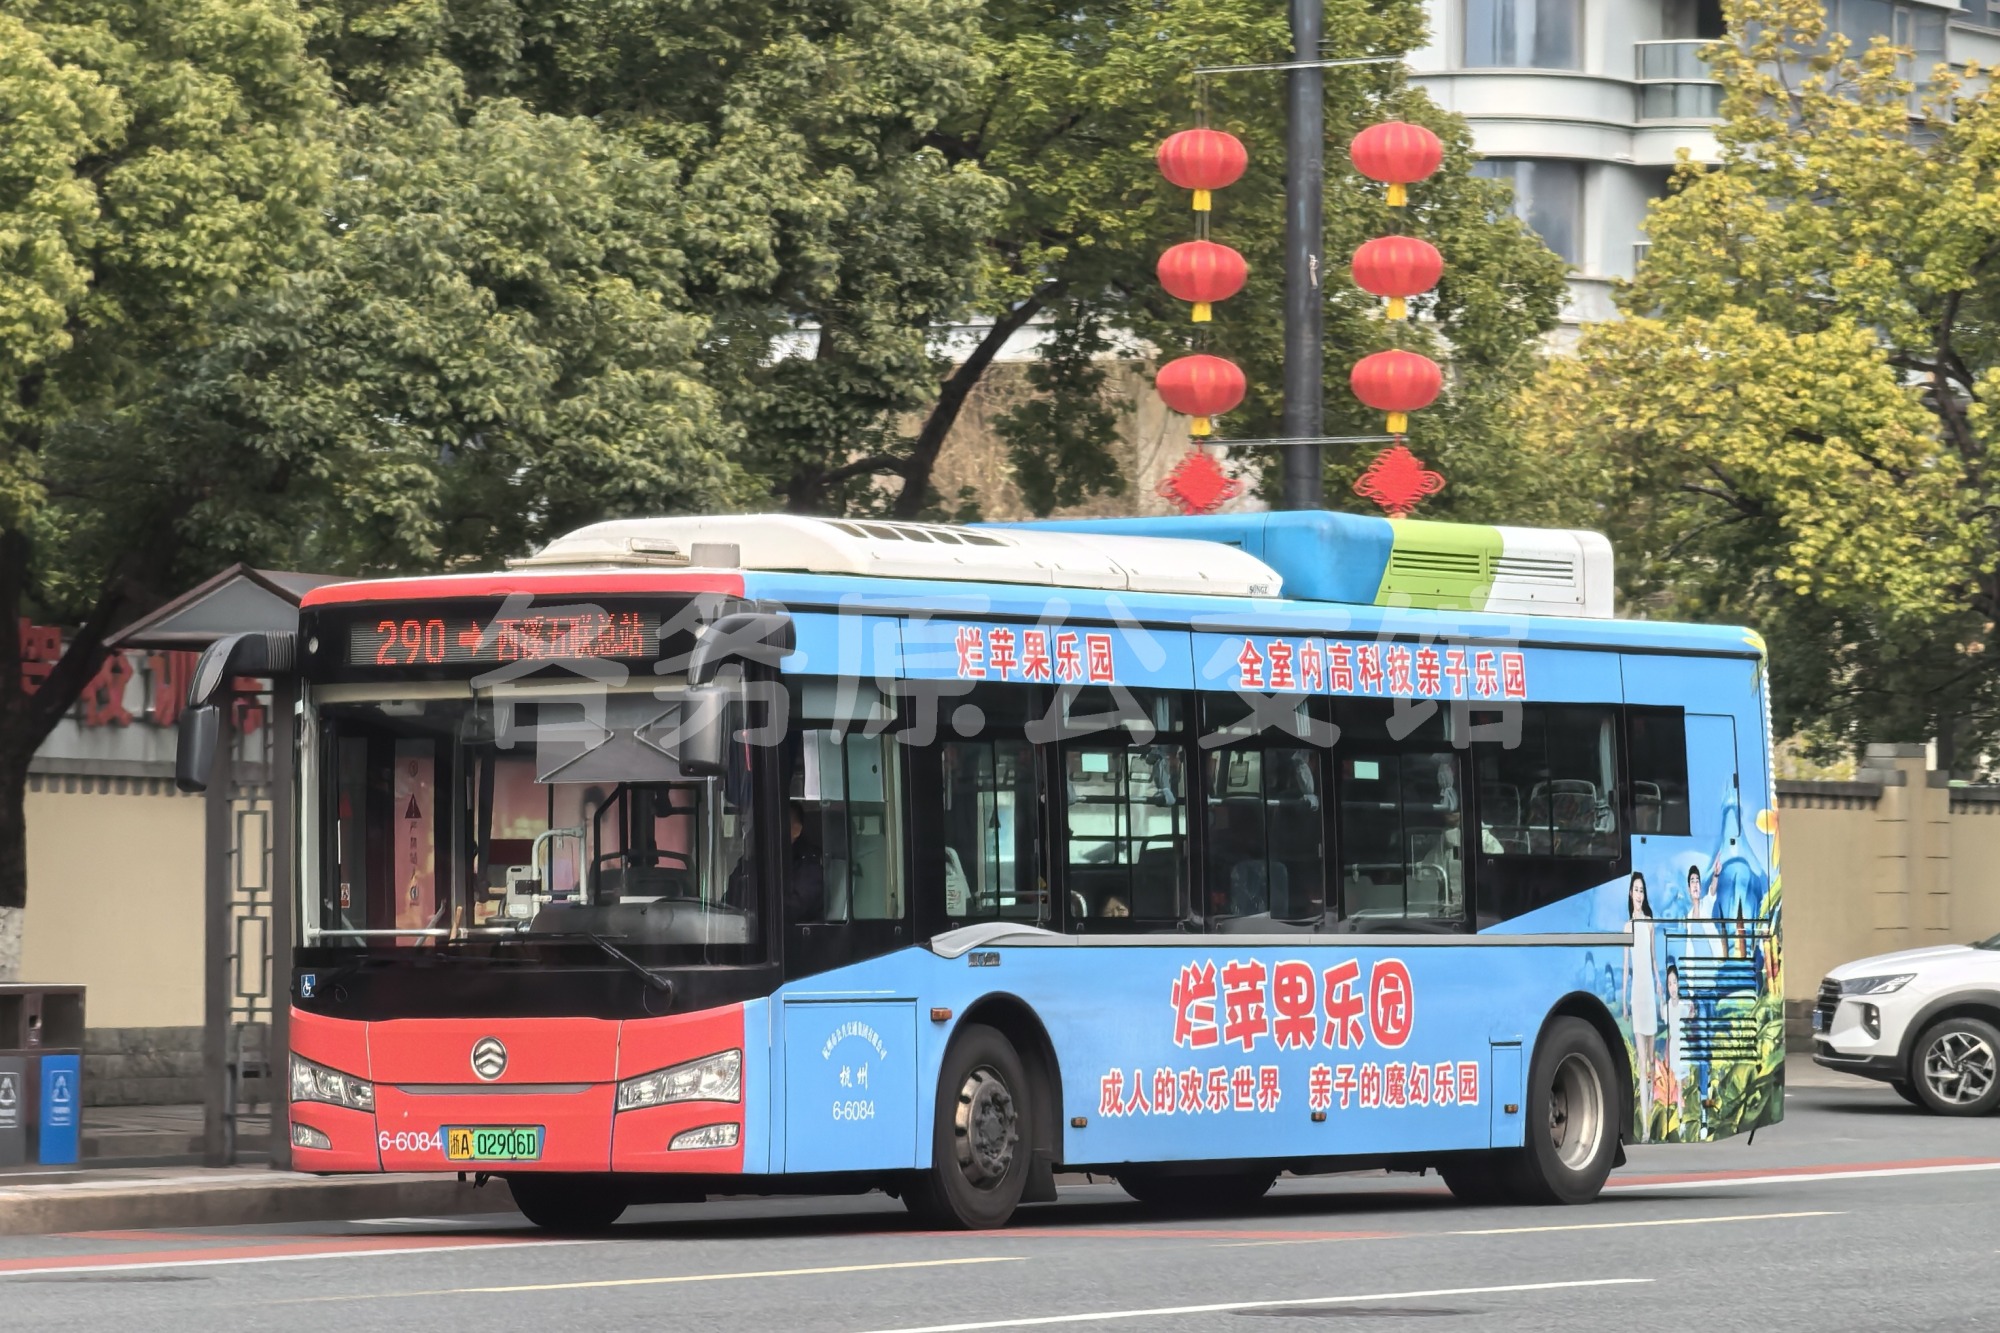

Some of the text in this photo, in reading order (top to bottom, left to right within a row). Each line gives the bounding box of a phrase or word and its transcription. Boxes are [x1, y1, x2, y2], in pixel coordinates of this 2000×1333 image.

[376, 612, 644, 665] 290 西溪五联总站
[955, 625, 1528, 700] 烂苹果乐园 全室内高科技亲子乐园
[1171, 957, 1415, 1052] 烂苹果乐园
[839, 1061, 869, 1090] 杭州
[1098, 1060, 1480, 1118] 成人的欢乐世界 亲子的魔幻乐园
[832, 1099, 876, 1121] 6-6084
[378, 1130, 442, 1151] 6-6084
